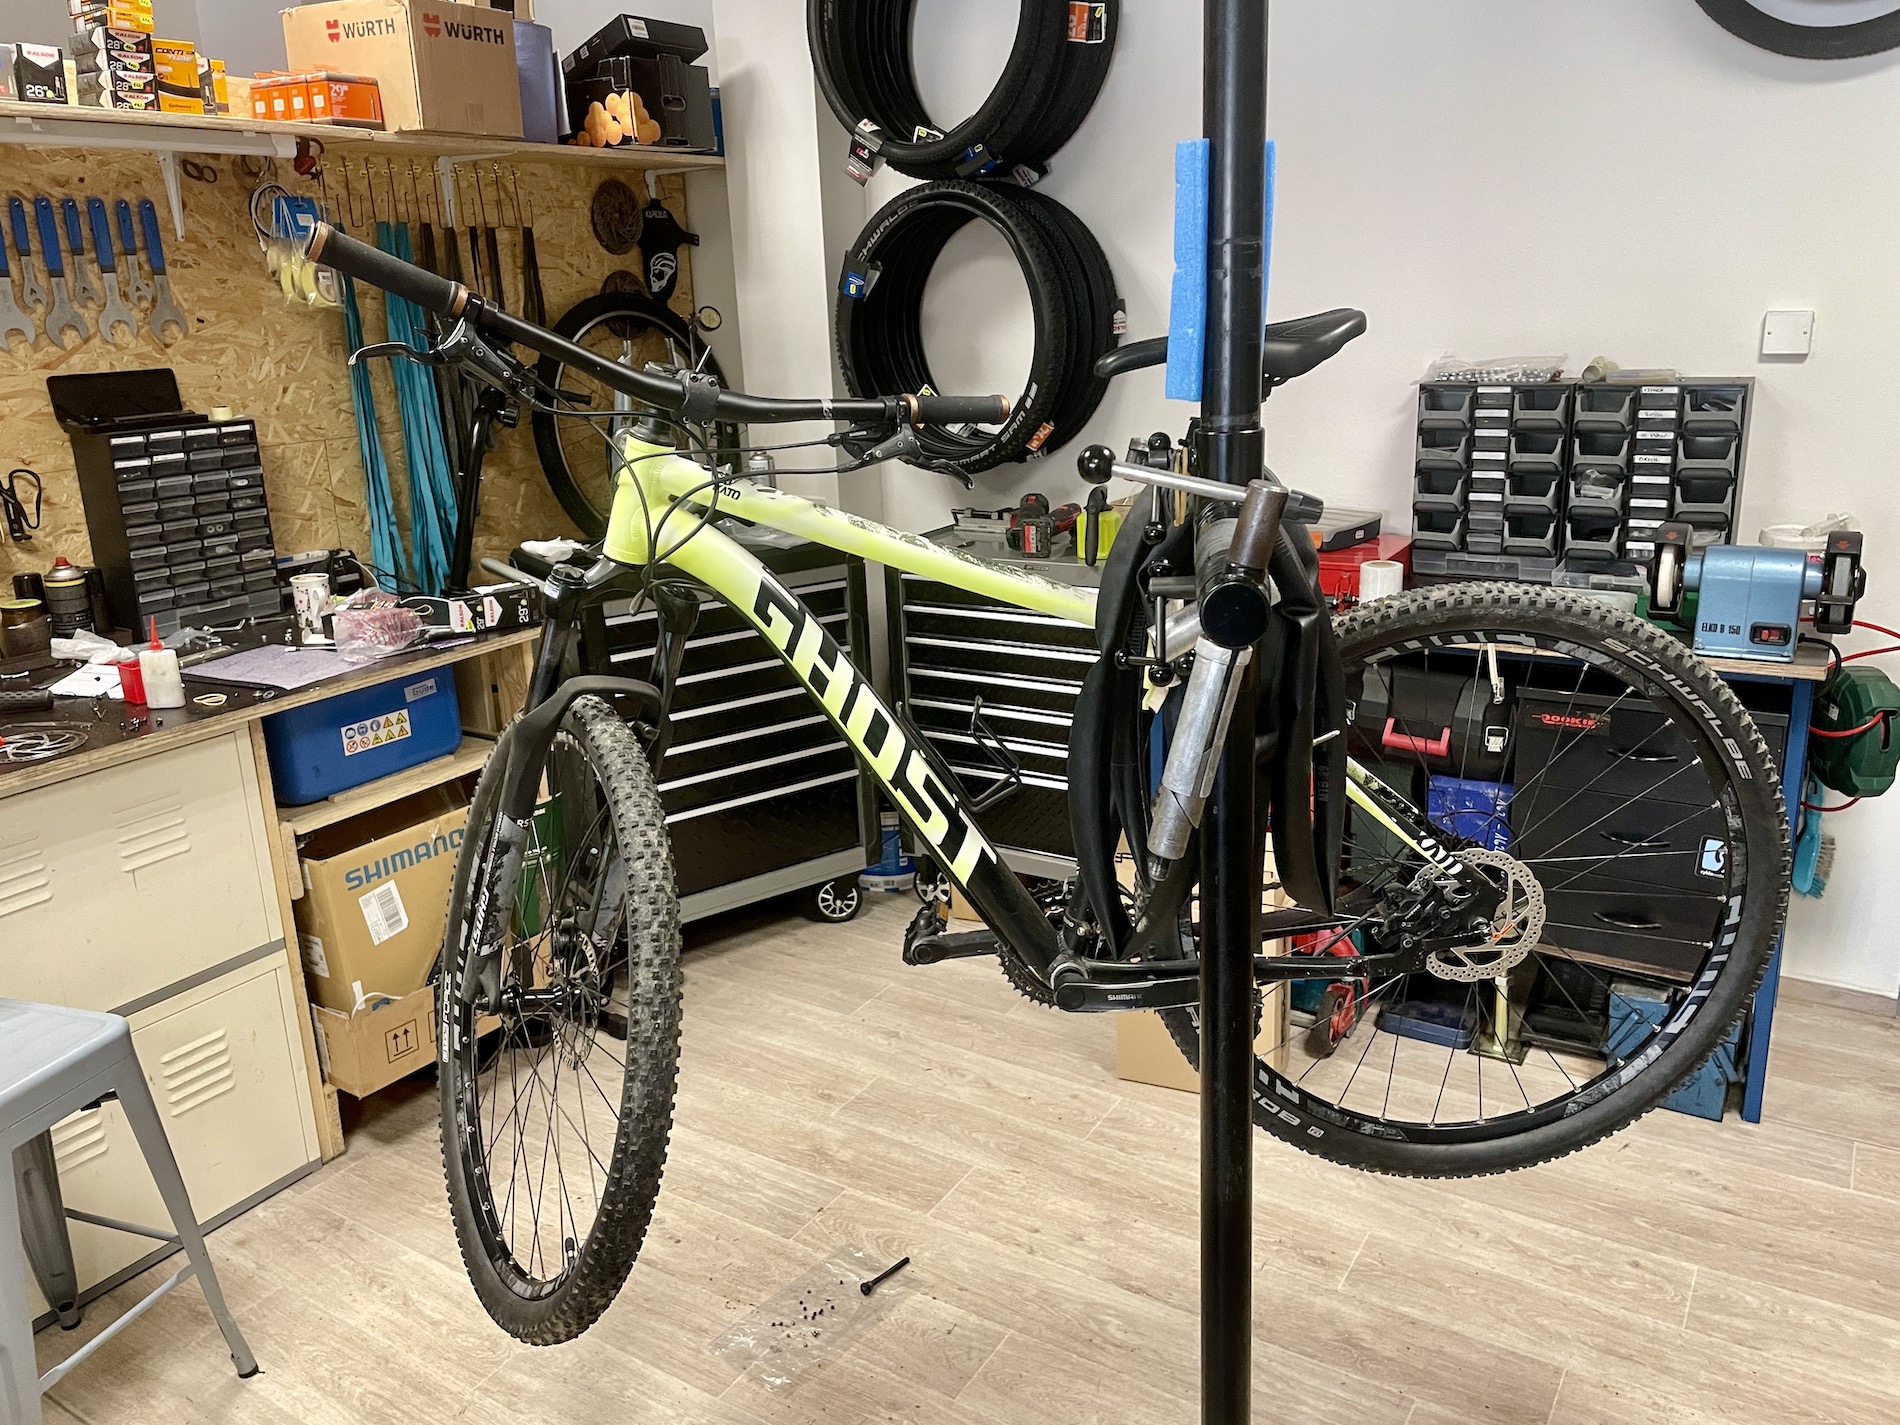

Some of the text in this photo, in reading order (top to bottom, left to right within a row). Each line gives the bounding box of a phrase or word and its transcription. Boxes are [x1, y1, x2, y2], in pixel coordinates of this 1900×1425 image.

[343, 18, 396, 39] WÜRTH
[444, 21, 505, 45] WÜRTH
[26, 50, 55, 58] RALSON
[1728, 625, 1741, 635] 150
[1601, 637, 1752, 780] SCHWALBE
[751, 565, 998, 888] GHOST
[344, 828, 465, 892] SHIMANO
